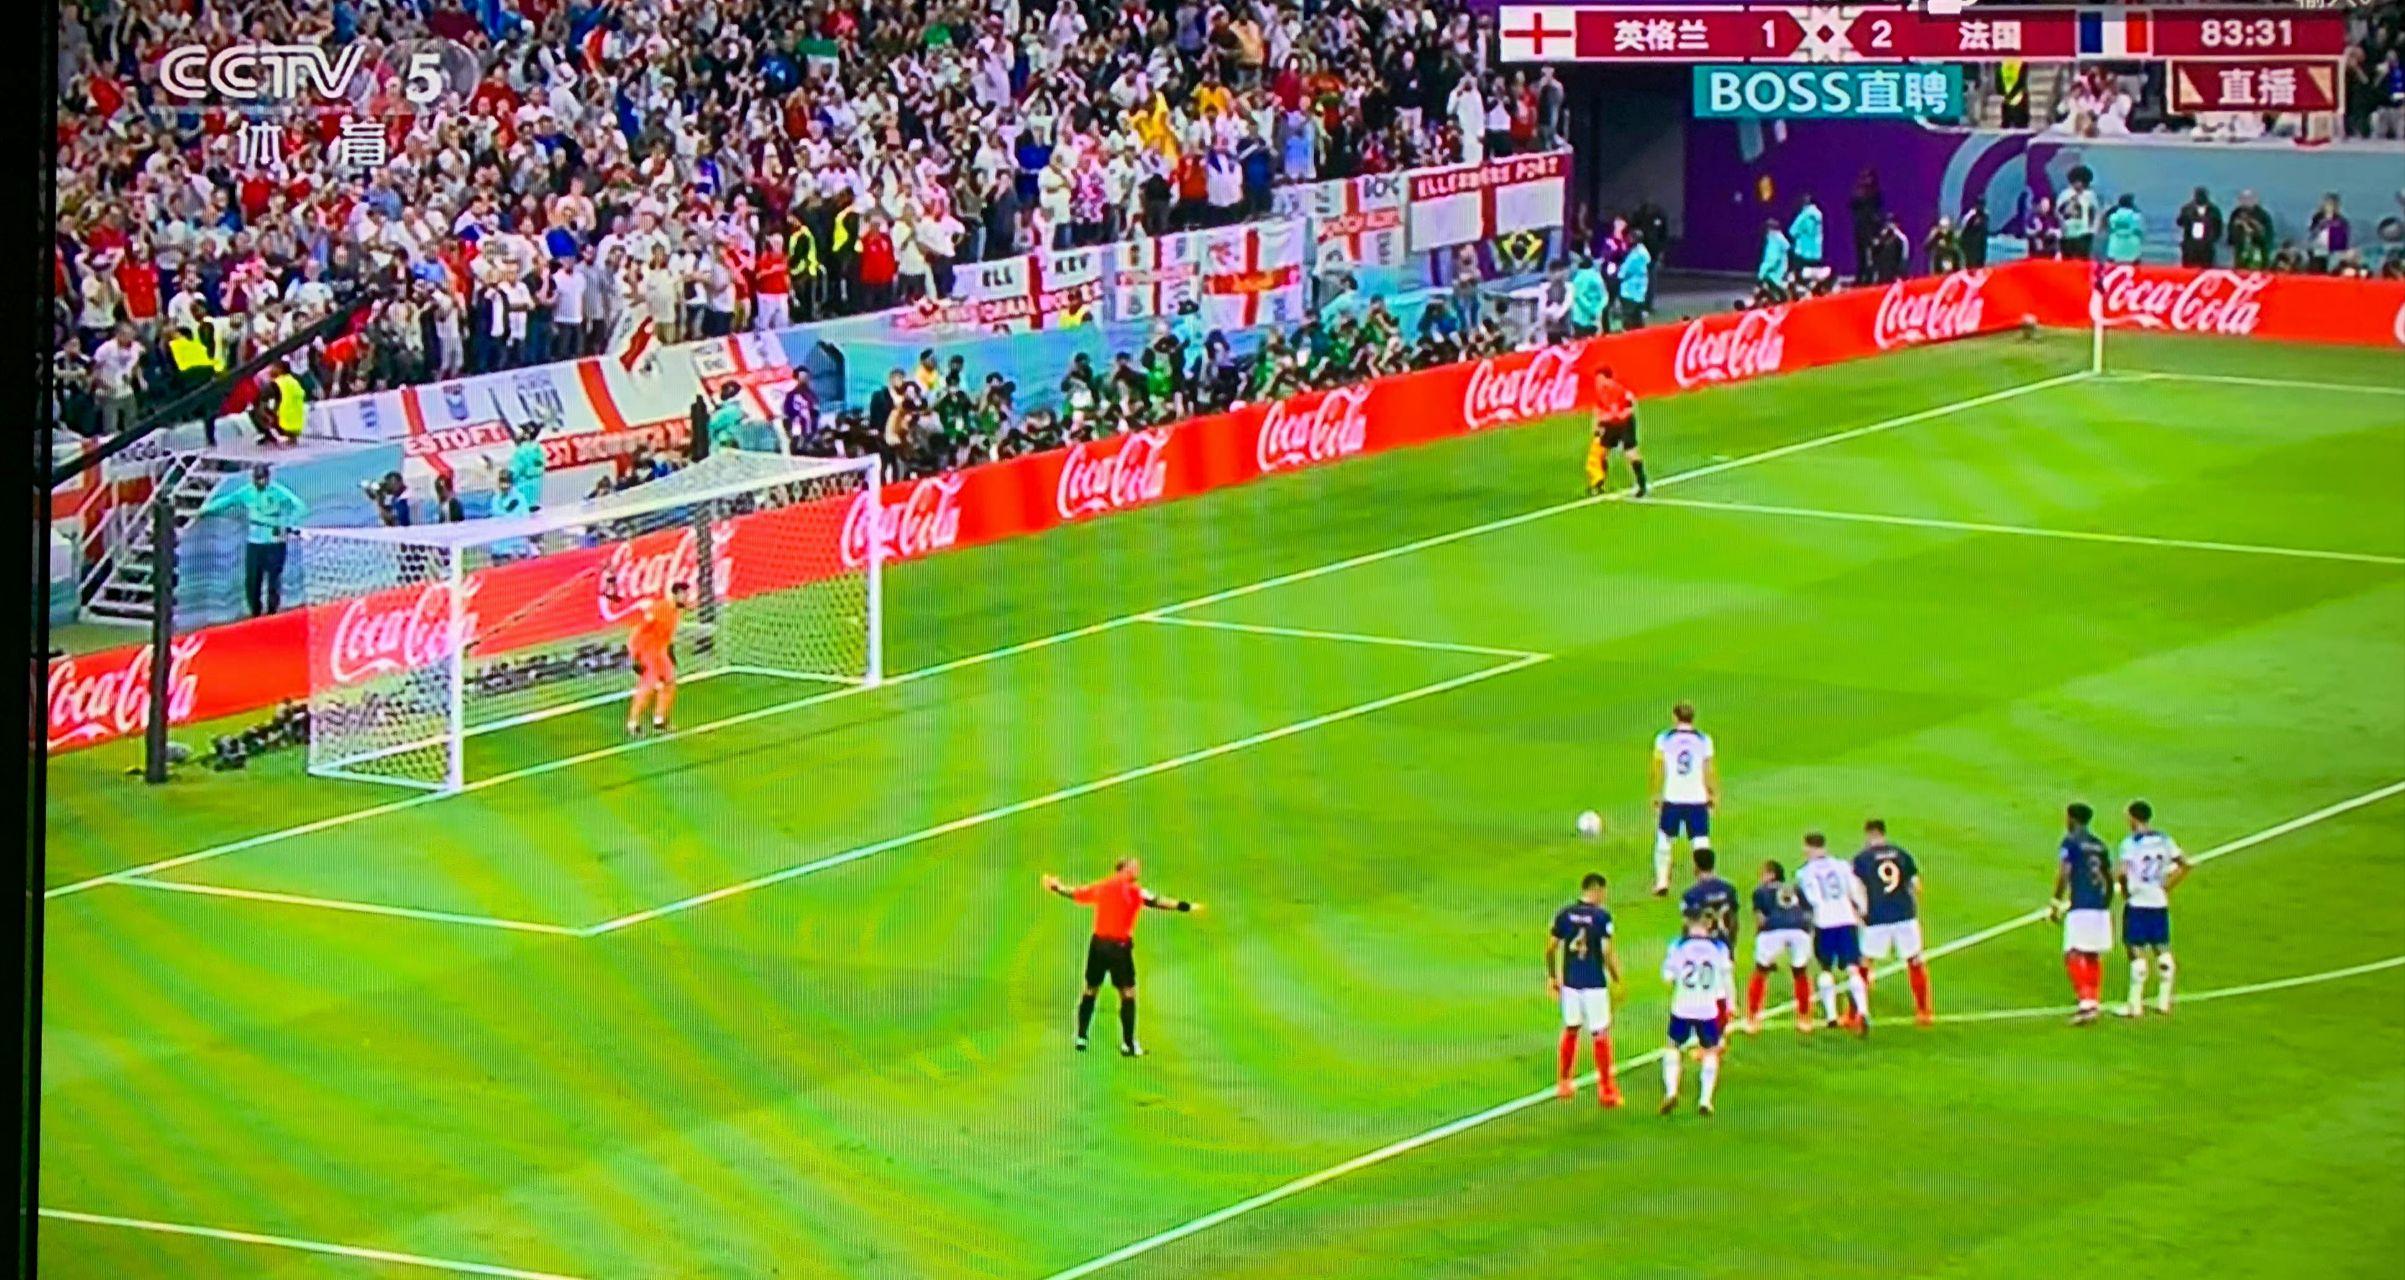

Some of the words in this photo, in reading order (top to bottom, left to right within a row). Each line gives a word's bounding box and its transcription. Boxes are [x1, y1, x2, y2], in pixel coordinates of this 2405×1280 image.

[1613, 18, 1709, 51] 英格兰
[1761, 19, 1776, 48] 1
[1871, 19, 1893, 48] 2
[1958, 20, 2022, 51] 法国
[2200, 18, 2293, 47] 83:31
[159, 44, 367, 98] CCTV
[406, 52, 443, 103] 5
[2218, 67, 2297, 106] 直播
[1677, 750, 1693, 775] 9
[1877, 860, 1901, 894] 9
[1569, 926, 1588, 961] 4
[1682, 960, 1716, 990] 20
